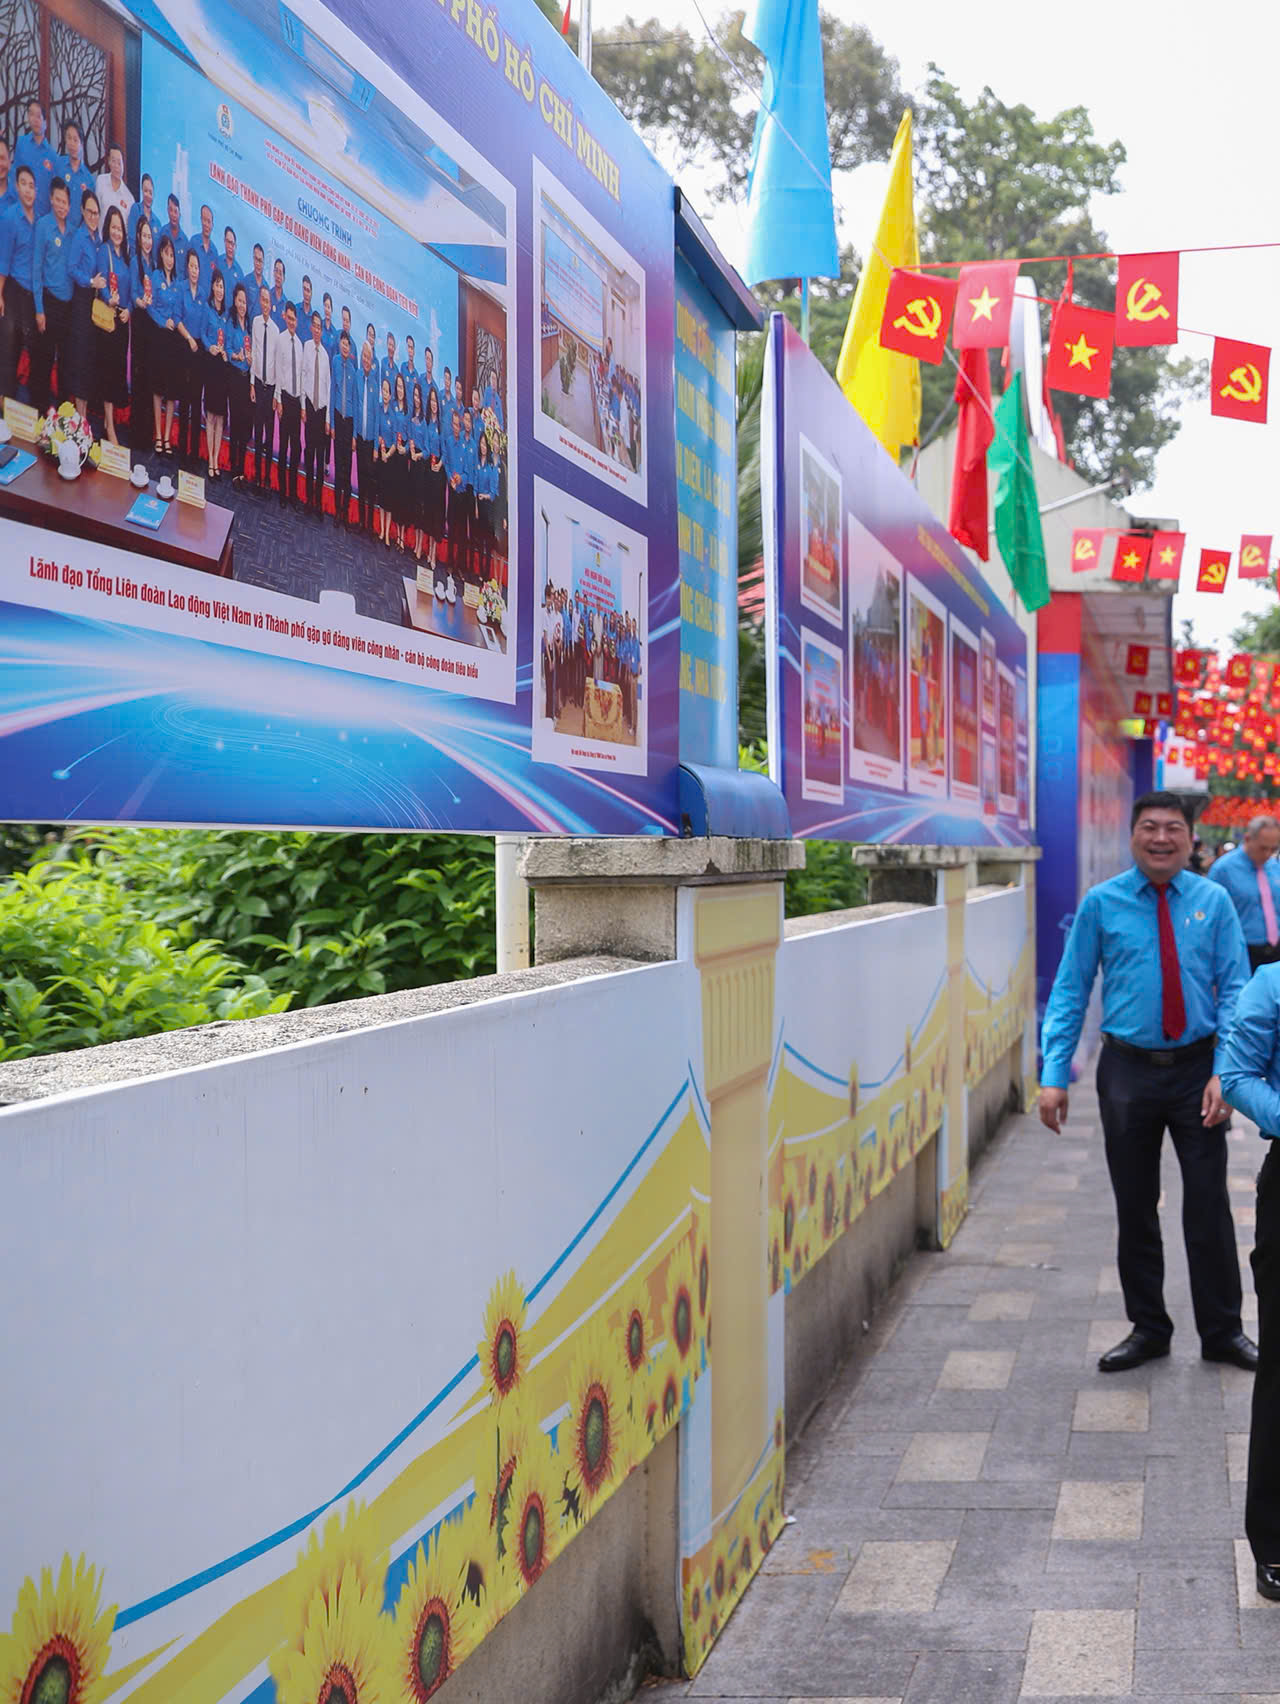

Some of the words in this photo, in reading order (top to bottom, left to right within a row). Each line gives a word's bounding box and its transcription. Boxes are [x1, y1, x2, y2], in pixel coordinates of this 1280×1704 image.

[503, 36, 535, 103] HỒ
[539, 81, 574, 150] CHÍ
[576, 121, 620, 202] MINH
[30, 556, 58, 582] Lãnh
[62, 565, 83, 590] đạo
[86, 568, 112, 596] Tổng
[116, 577, 138, 600] Liên
[141, 584, 165, 606] đoàn
[168, 589, 185, 610] Lao
[188, 595, 210, 618] động
[213, 600, 230, 624] Việt
[232, 606, 250, 626] Nam
[254, 611, 264, 628] và
[266, 614, 288, 635] Thành
[291, 621, 306, 638] phố
[307, 625, 320, 645] gặp
[322, 629, 332, 644] gỡ
[352, 636, 366, 653] viên
